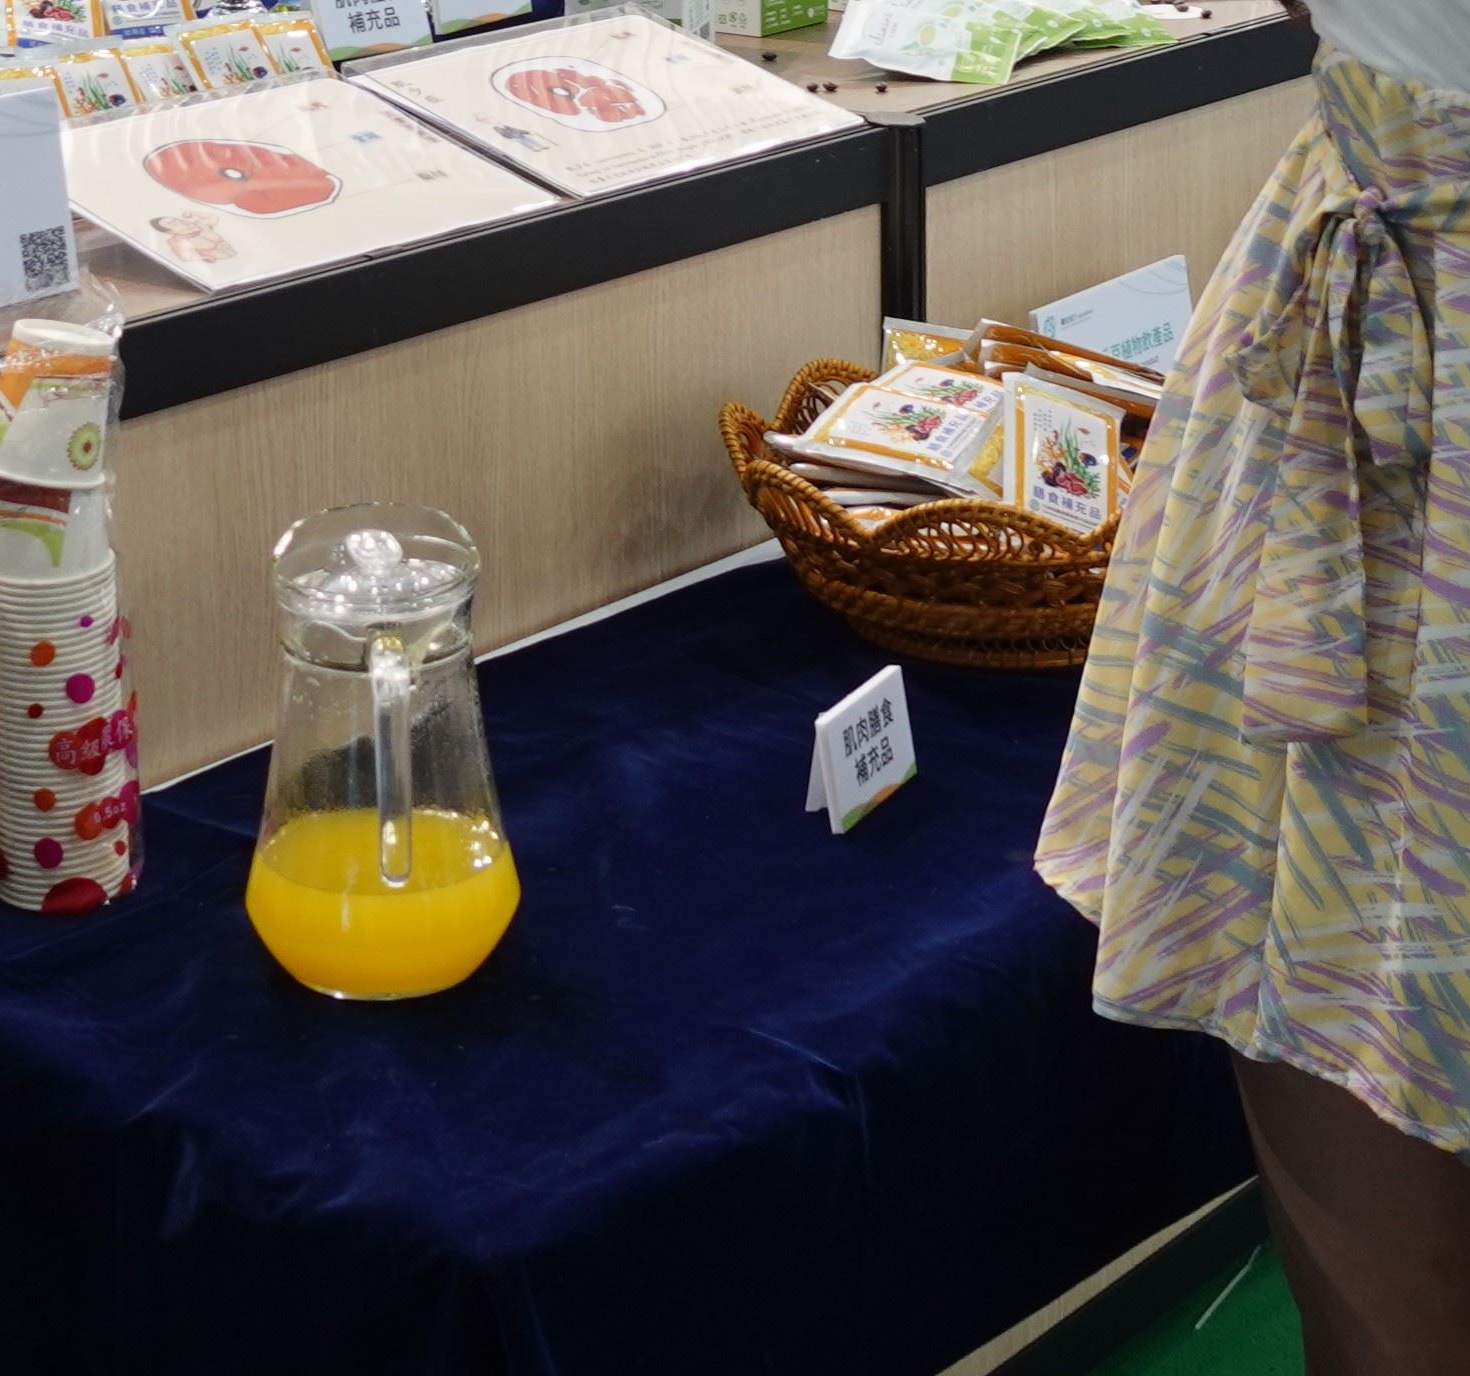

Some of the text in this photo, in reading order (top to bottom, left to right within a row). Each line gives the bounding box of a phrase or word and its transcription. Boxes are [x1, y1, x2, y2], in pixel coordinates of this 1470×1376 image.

[348, 7, 401, 34] 補充品
[842, 697, 895, 758] 肌肉膳食
[854, 736, 894, 786] 補充品
